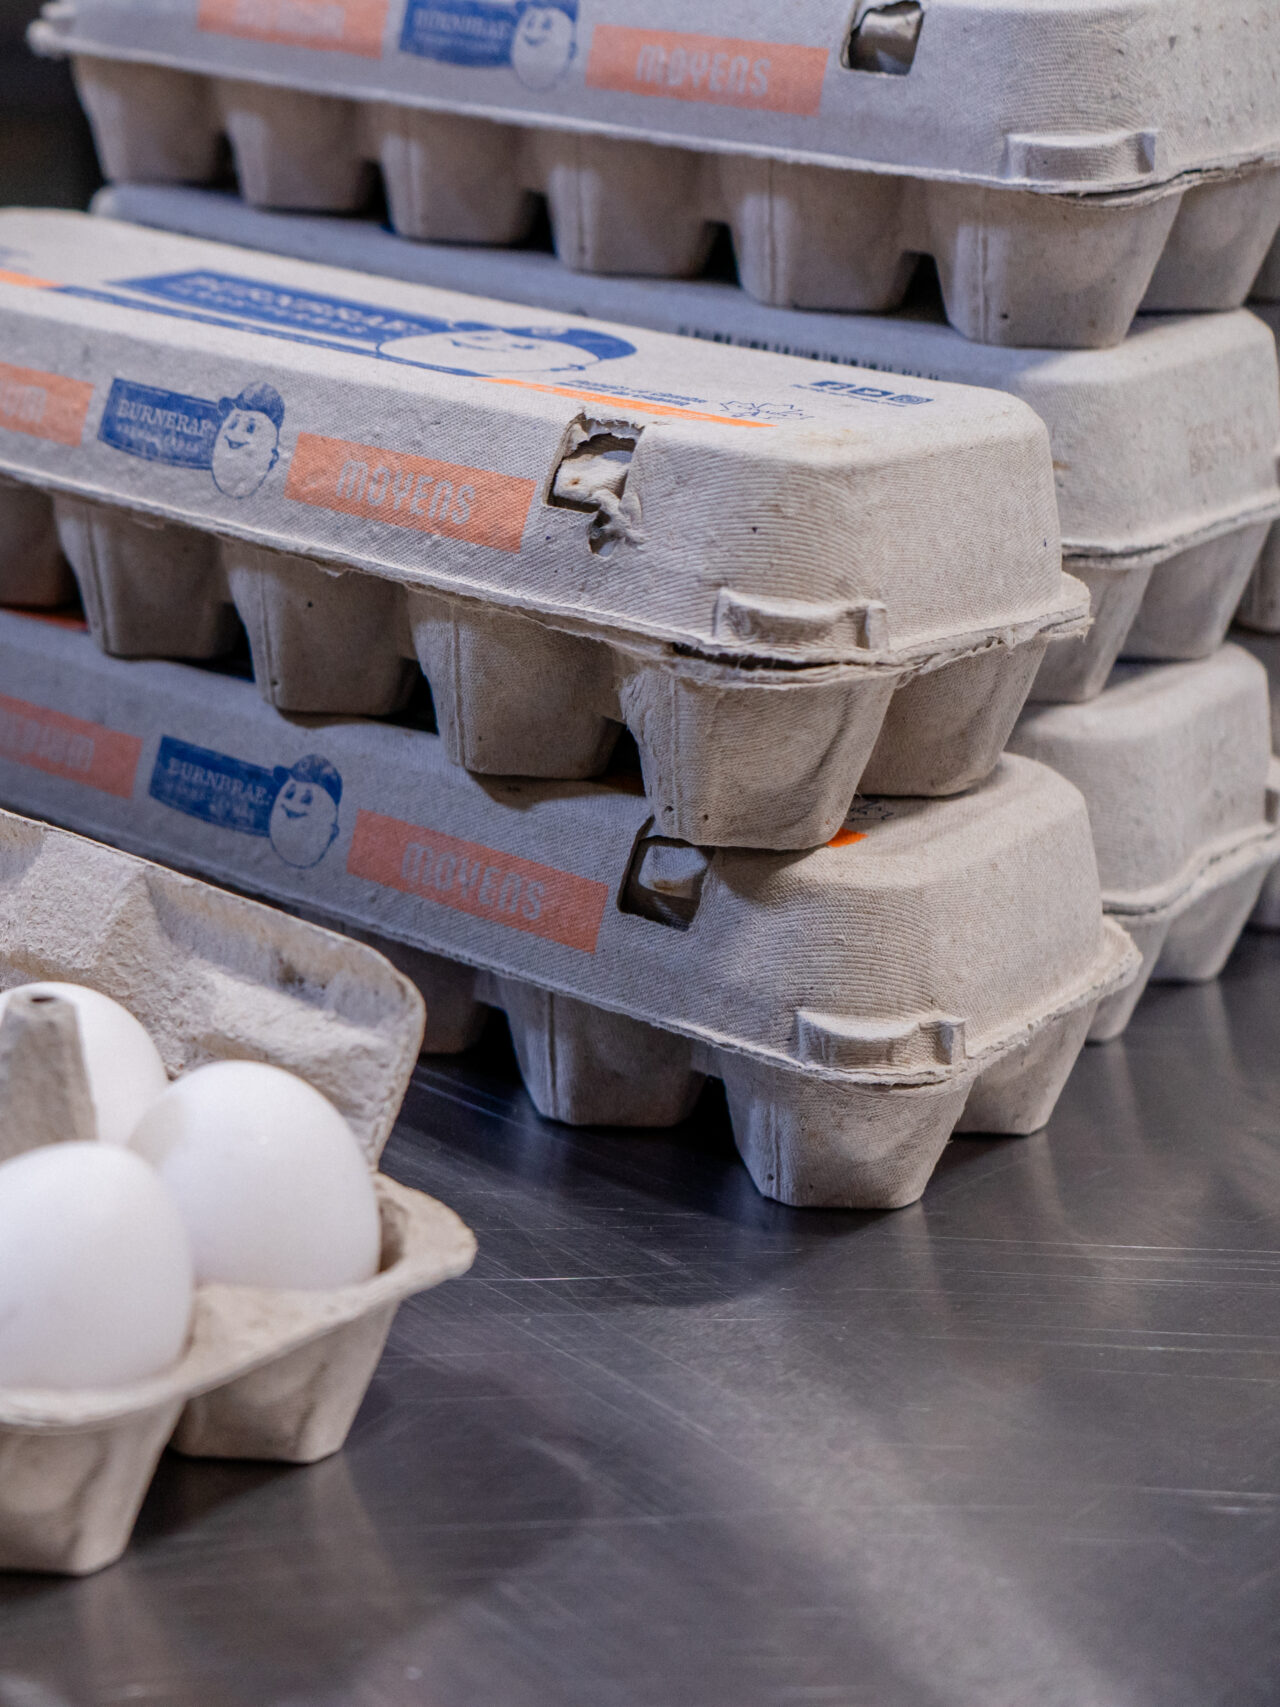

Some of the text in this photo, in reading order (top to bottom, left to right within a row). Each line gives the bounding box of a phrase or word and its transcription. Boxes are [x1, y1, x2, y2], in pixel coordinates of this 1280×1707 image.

[635, 44, 772, 97] MOYENS
[335, 458, 477, 526] MOYENS
[400, 841, 546, 921] MOYENS
